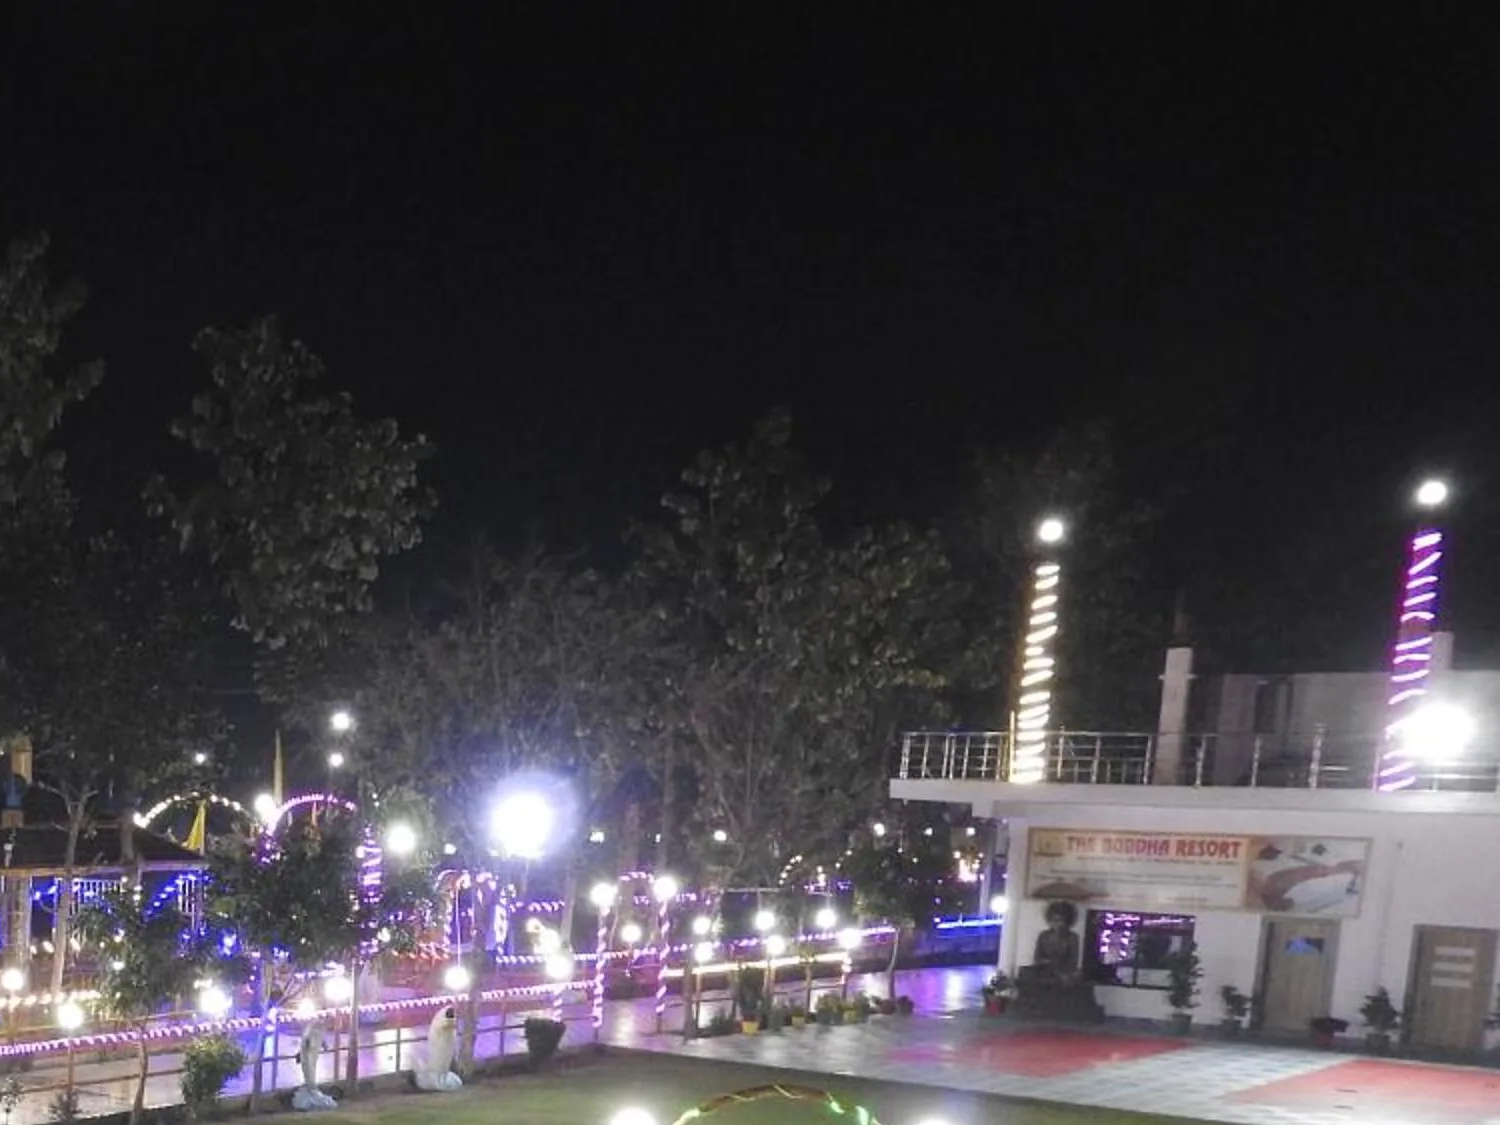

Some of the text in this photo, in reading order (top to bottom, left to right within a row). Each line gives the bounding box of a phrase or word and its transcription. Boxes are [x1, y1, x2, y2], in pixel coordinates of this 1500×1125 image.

[1066, 836, 1243, 858] THE BUDDHA RESORT
